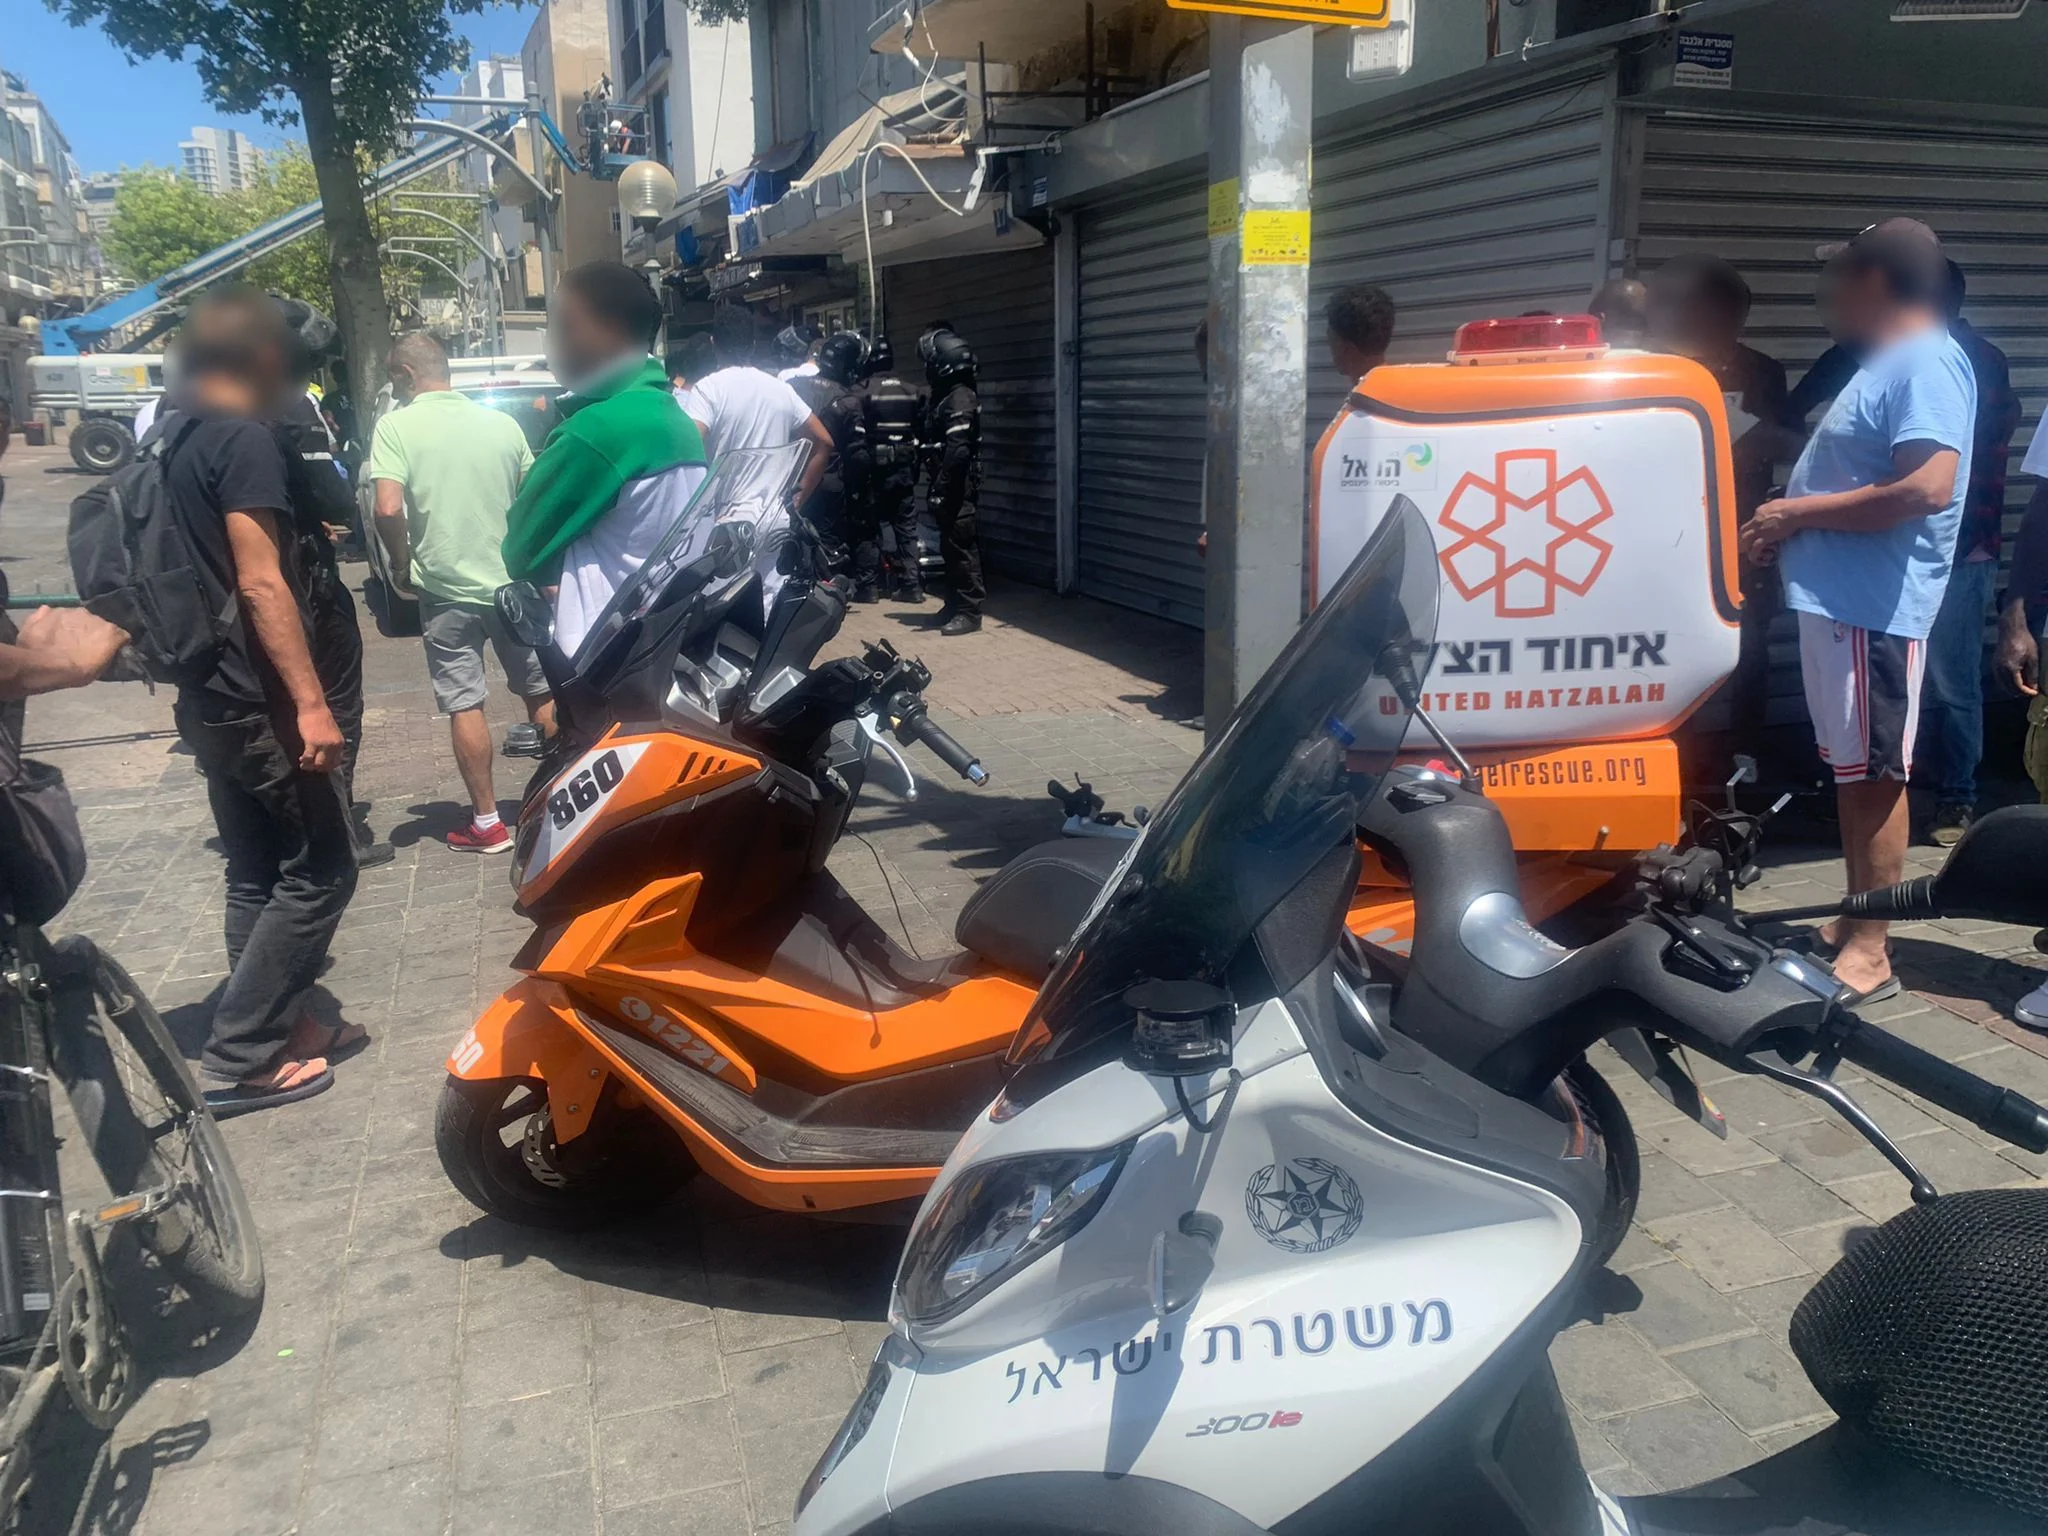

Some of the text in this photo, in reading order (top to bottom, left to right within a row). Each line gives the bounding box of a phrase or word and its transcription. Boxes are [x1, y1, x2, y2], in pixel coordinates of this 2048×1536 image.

[1396, 630, 1669, 677] איחוד הצל
[1379, 682, 1666, 716] UITED HATZALAH
[549, 749, 625, 831] 860
[1478, 757, 1647, 788] elrescue.org
[647, 1014, 731, 1075] 1221
[1004, 1297, 1455, 1404] משטרת ישראל
